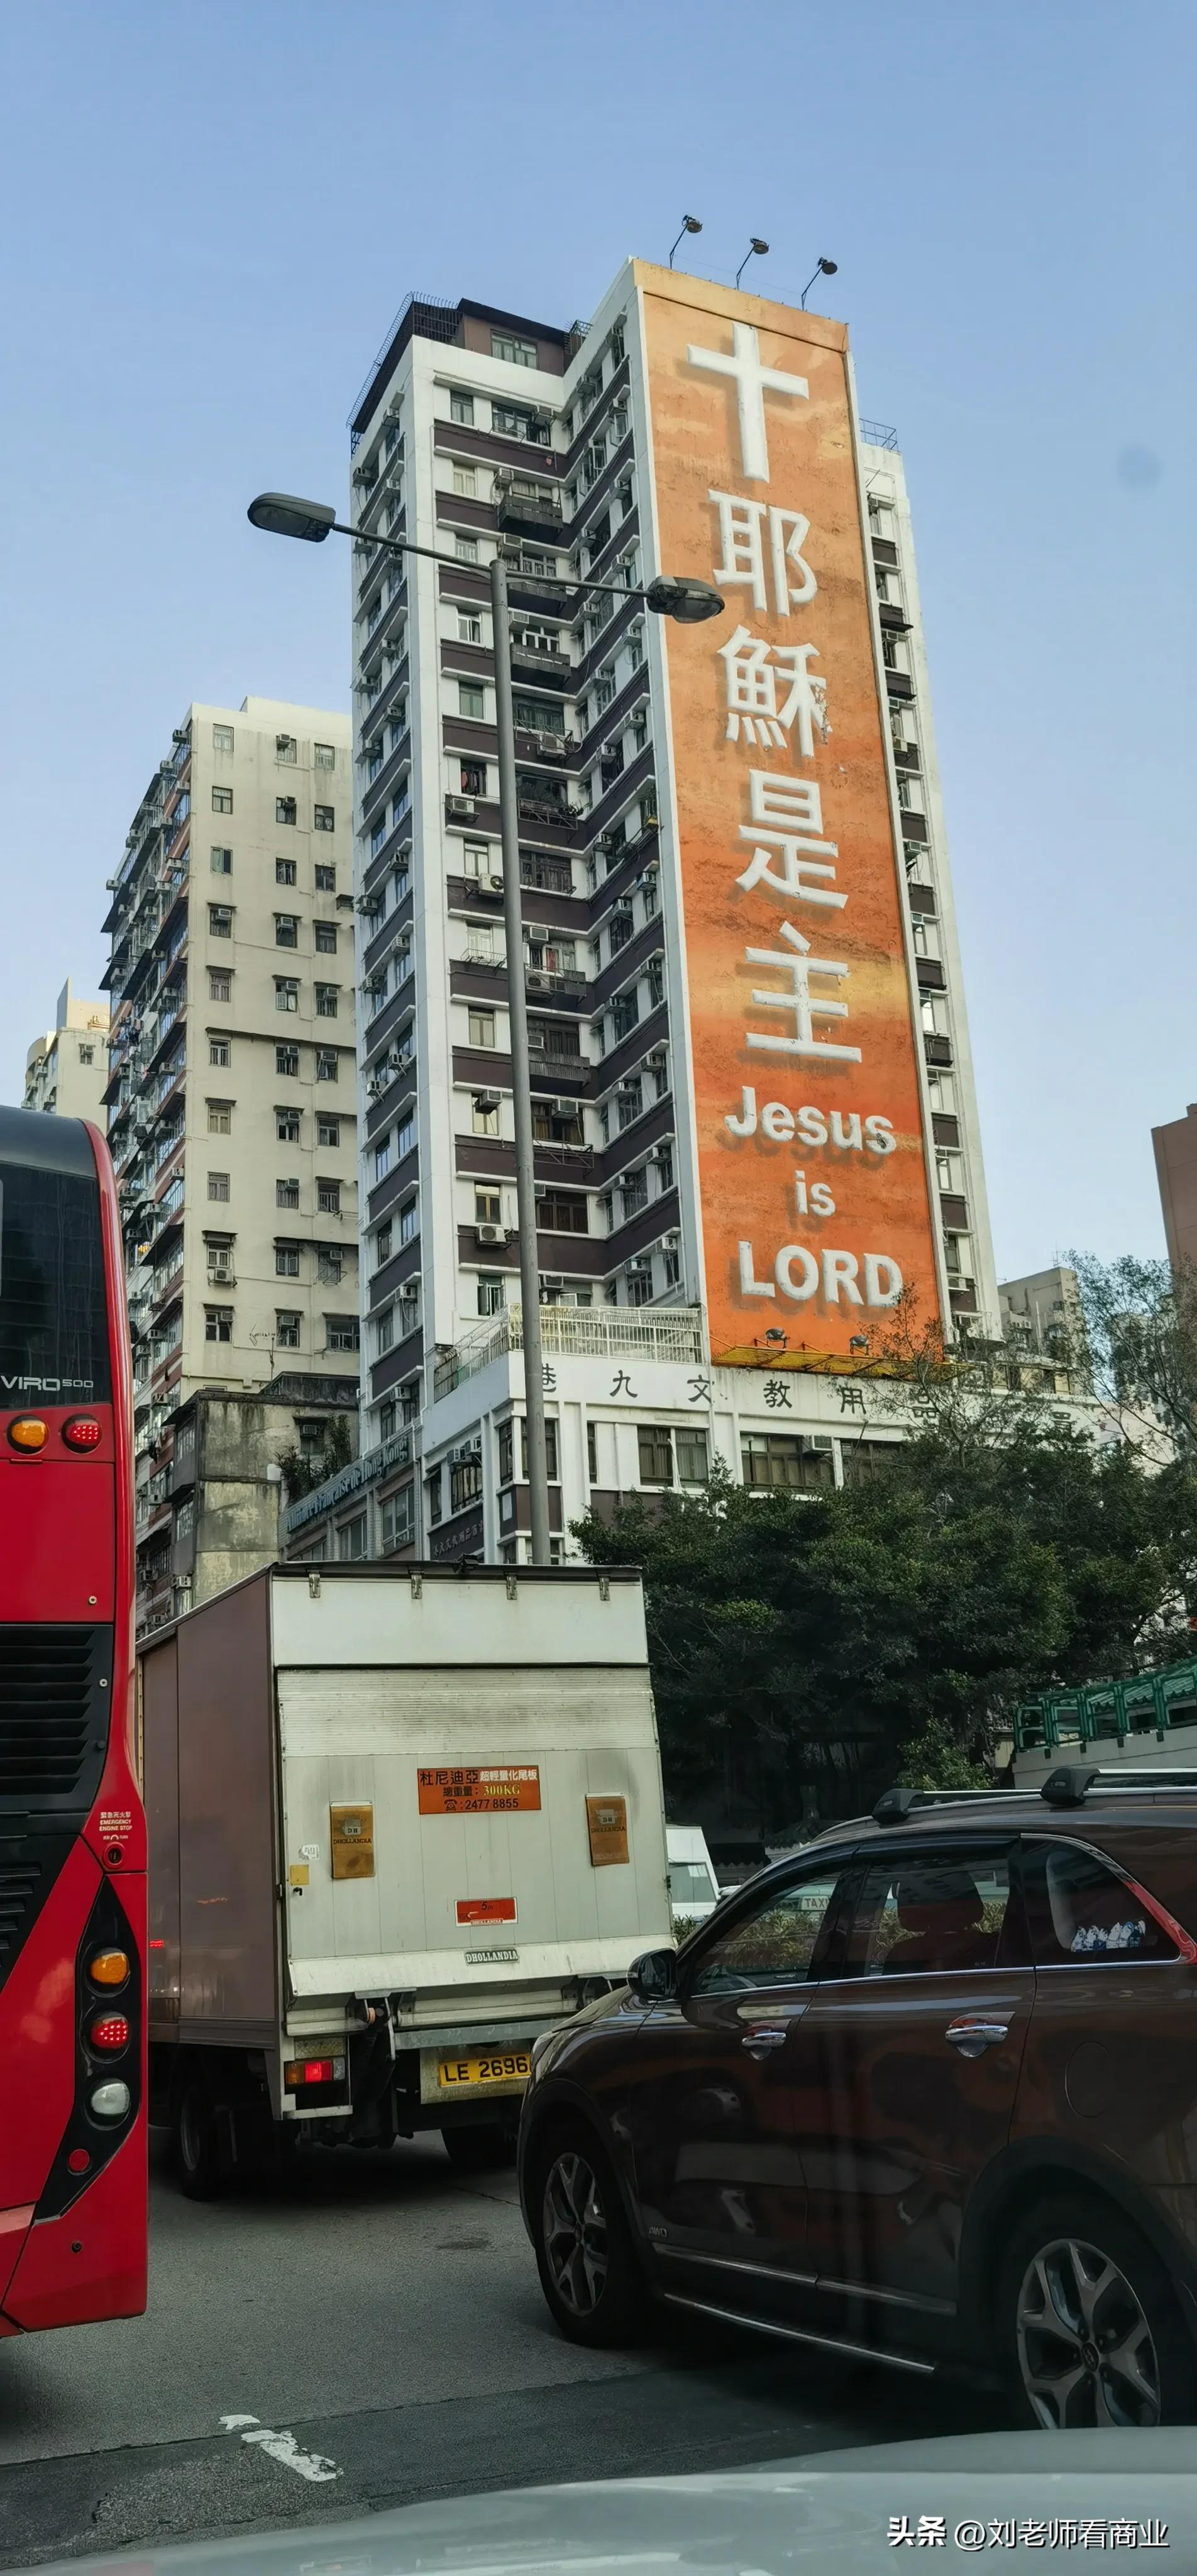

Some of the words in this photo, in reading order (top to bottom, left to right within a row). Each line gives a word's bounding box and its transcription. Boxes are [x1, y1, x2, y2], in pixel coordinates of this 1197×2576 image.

[708, 489, 862, 1063] 耶穌是主
[724, 1086, 897, 1155] Jesus
[795, 1171, 836, 1218] is
[739, 1240, 903, 1307] LORD
[421, 1770, 479, 1785] 杜尼迪亞
[483, 1784, 520, 1796] 300KG
[493, 1798, 519, 1809] 8855
[805, 1898, 828, 1907] TAXI
[466, 1950, 518, 1962] DHOLLANDIA
[444, 2063, 470, 2082] LE
[478, 2056, 528, 2078] 2696
